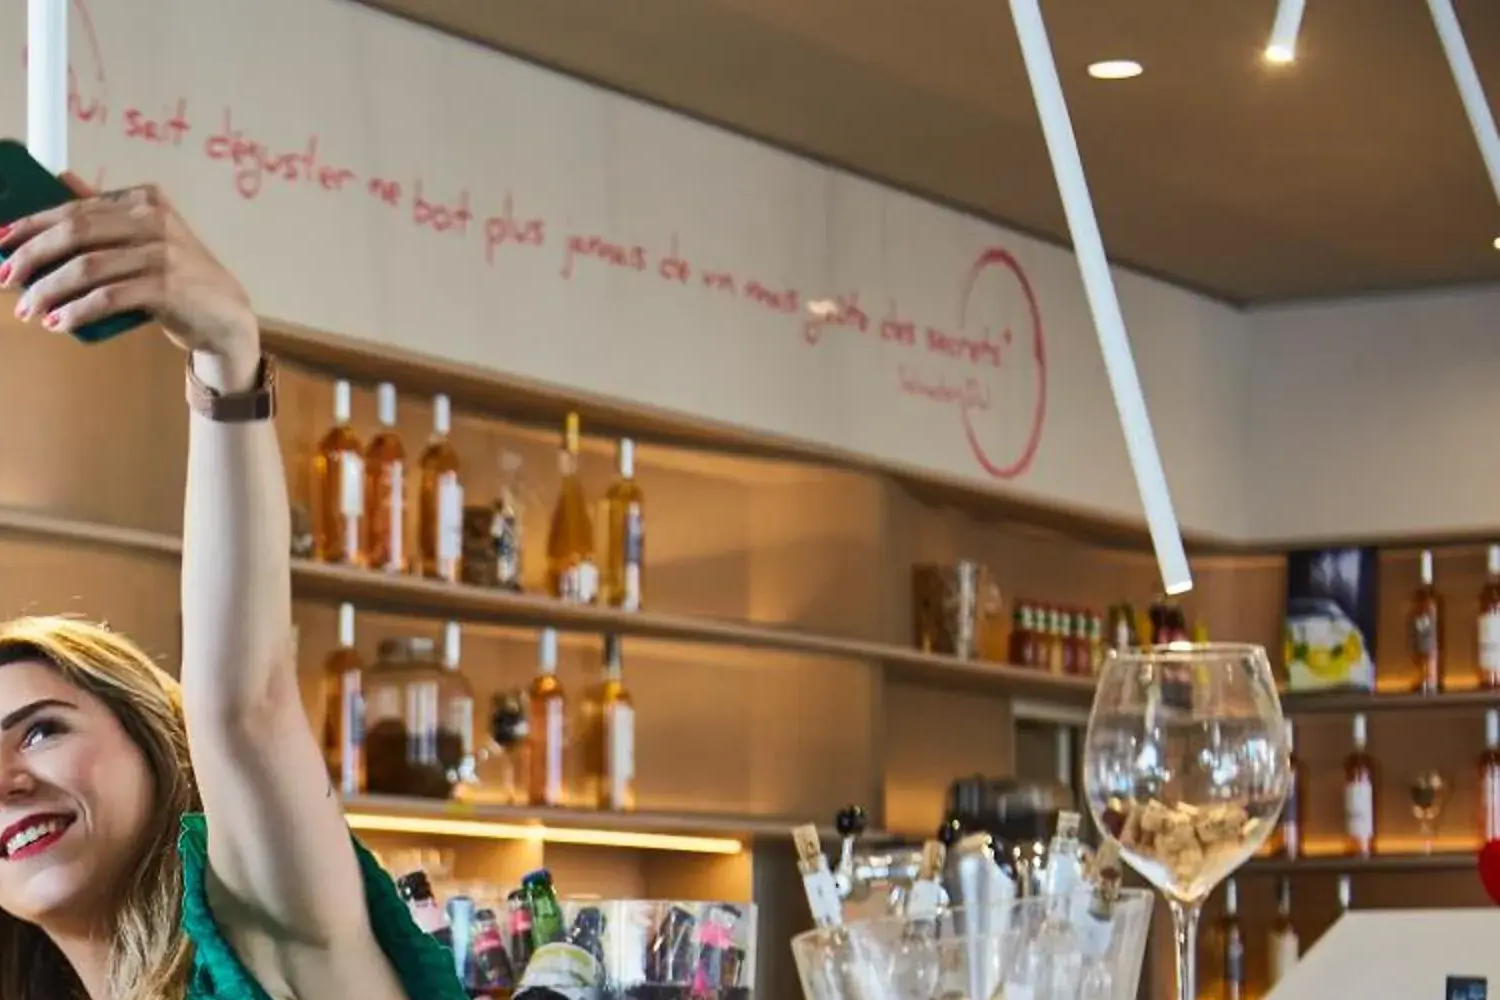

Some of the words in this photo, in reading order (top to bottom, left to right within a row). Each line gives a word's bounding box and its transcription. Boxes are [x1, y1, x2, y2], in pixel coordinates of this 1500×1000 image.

[205, 104, 355, 200] déguster
[484, 188, 546, 267] plus
[659, 231, 690, 285] de
